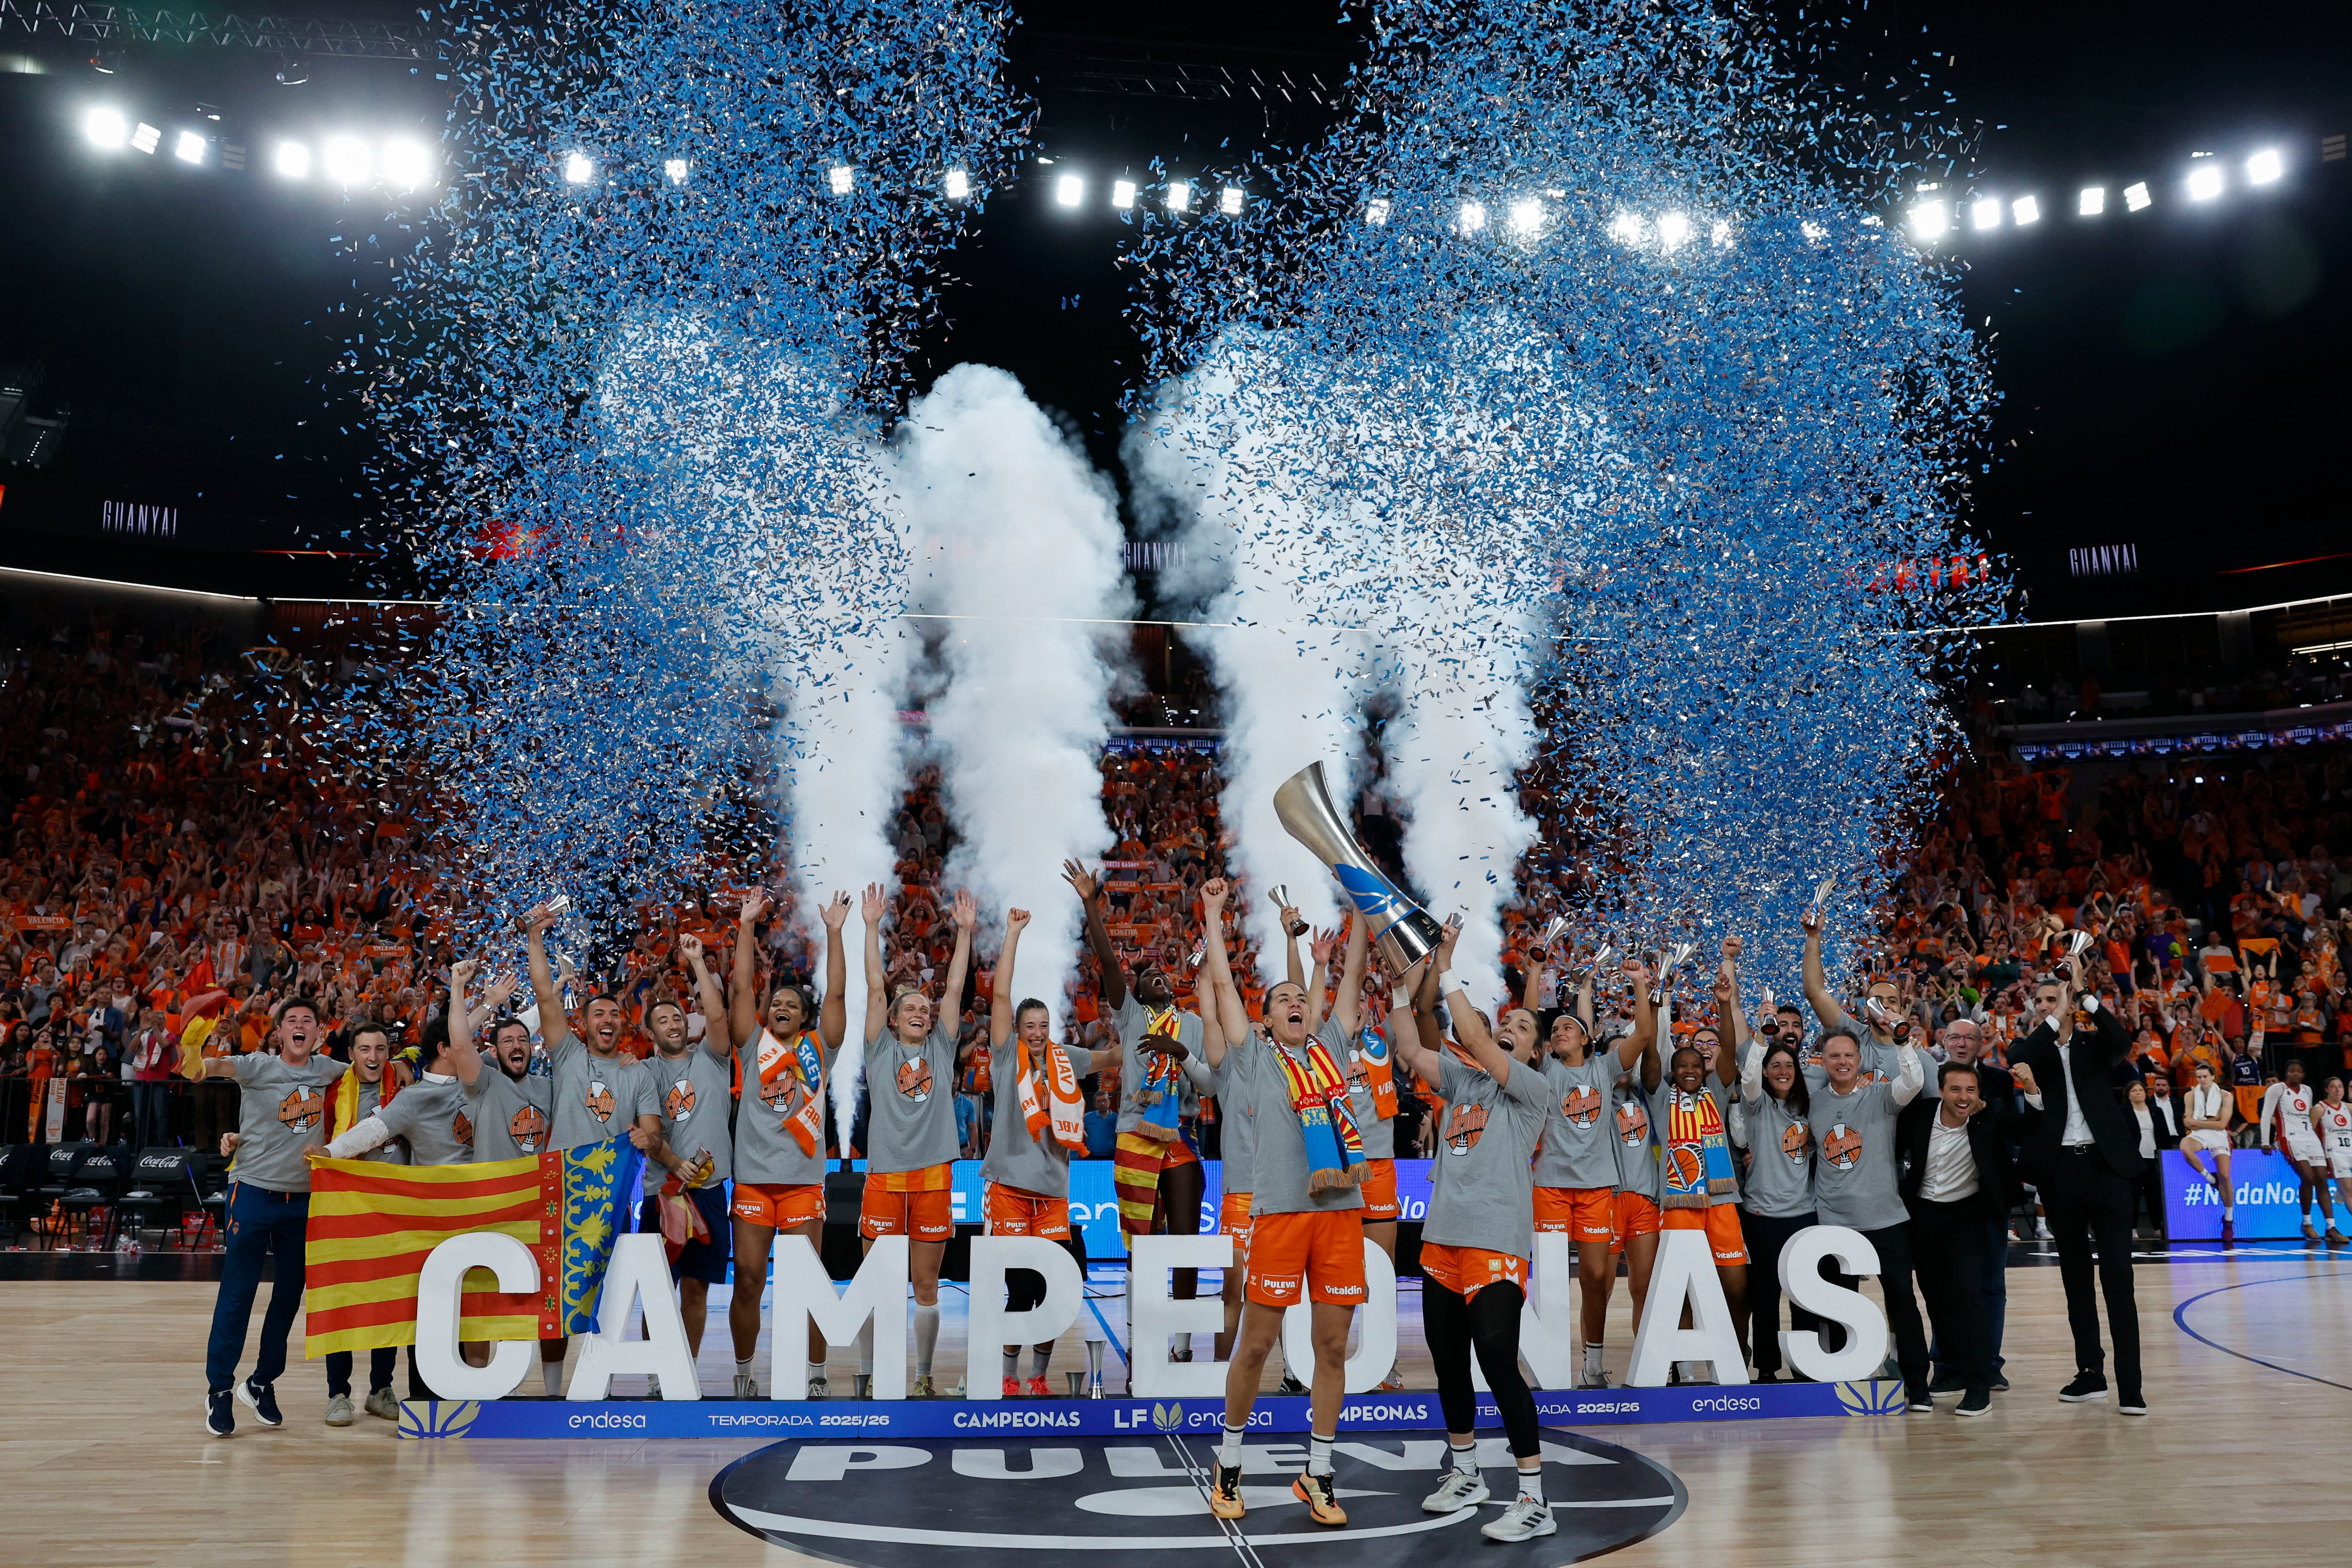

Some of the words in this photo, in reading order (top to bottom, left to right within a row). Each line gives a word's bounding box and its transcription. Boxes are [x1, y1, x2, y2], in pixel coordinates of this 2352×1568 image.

[27, 916, 65, 925] VALENCIA
[979, 1066, 985, 1075] 5
[2240, 1066, 2250, 1075] 10
[1562, 1092, 1602, 1116] CAMPIONES
[1336, 1100, 1359, 1130] VALENCIA
[2302, 1121, 2308, 1131] 7
[1823, 1131, 1863, 1160] CAMPIONES
[2338, 1137, 2351, 1147] 10
[869, 1219, 893, 1227] PULEVA
[1041, 1226, 1067, 1235] Vitaldin
[1264, 1279, 1296, 1289] PULEVA
[1325, 1285, 1362, 1295] Vitaldin
[415, 1225, 1888, 1401] CAMPEONAS
[1577, 1402, 1640, 1414] 2025/26
[1692, 1395, 1760, 1412] endesa
[569, 1411, 646, 1428] endesa
[708, 1416, 813, 1425] TEMPORADA
[820, 1415, 890, 1426] 2025/26
[954, 1412, 1080, 1428] CAMPEONAS
[1114, 1409, 1147, 1427] LF
